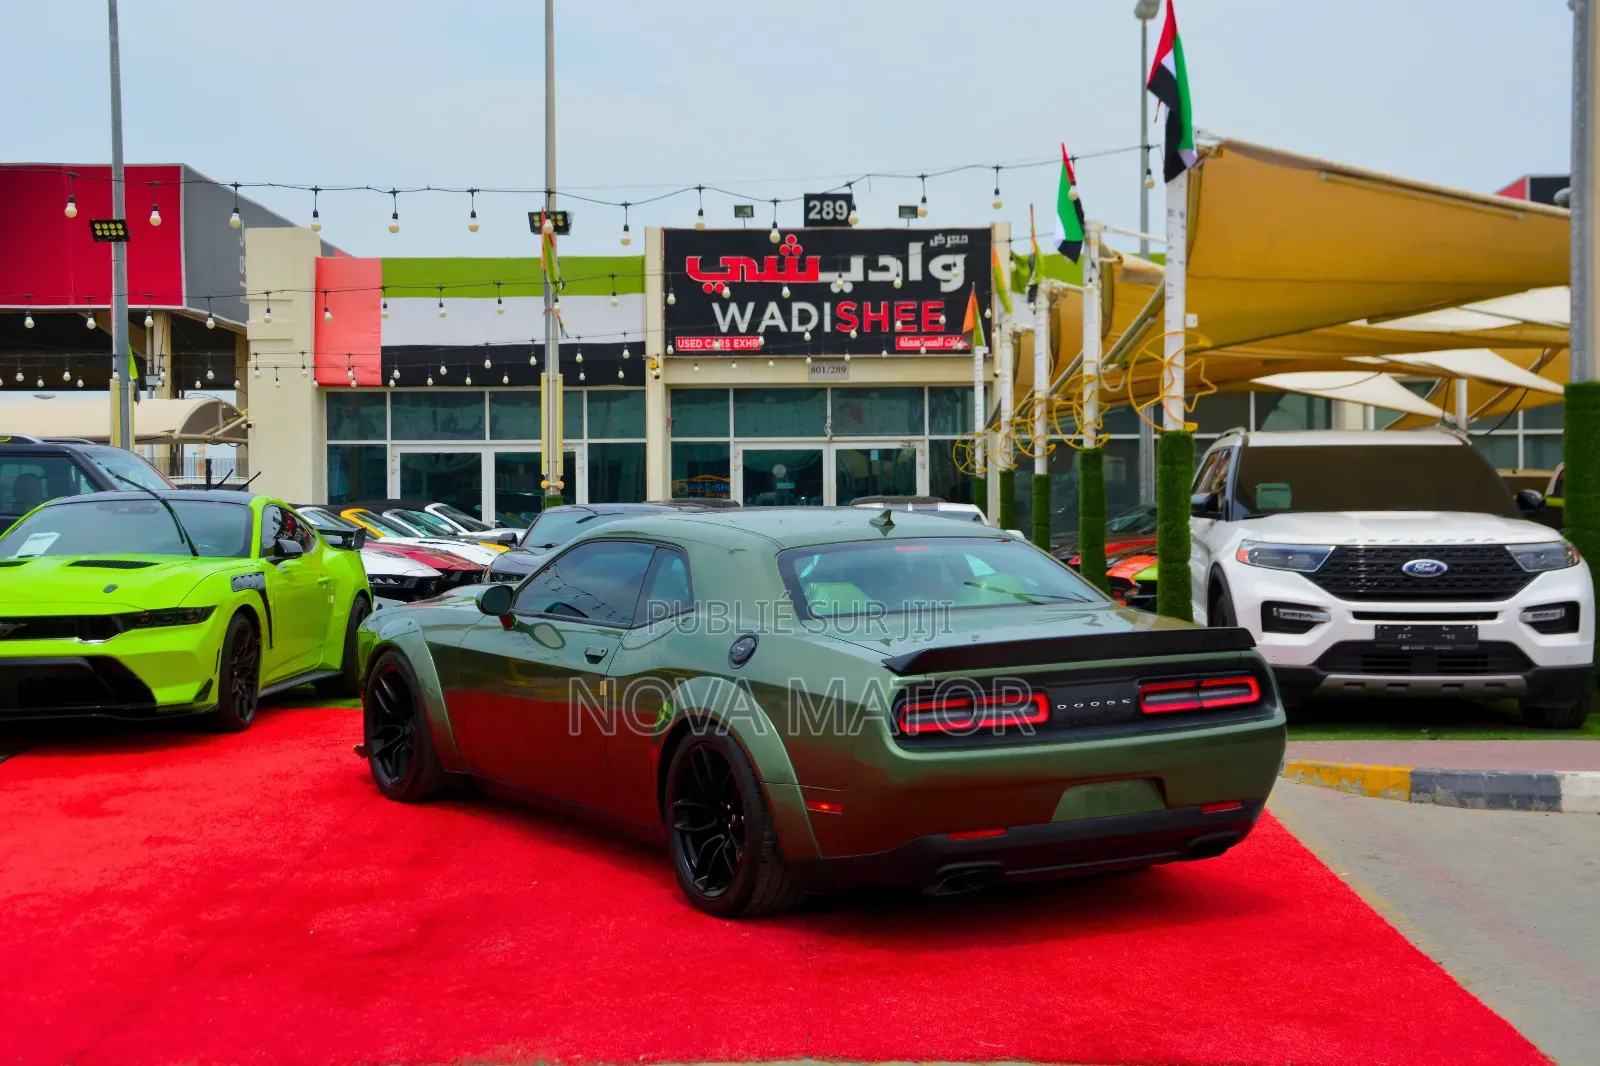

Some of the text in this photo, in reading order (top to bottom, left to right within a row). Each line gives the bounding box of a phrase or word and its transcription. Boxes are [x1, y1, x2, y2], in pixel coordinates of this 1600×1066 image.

[808, 200, 848, 220] 289
[929, 233, 969, 248] معرض
[711, 301, 946, 333] WADISHEE
[677, 339, 703, 349] USED
[733, 339, 759, 349] EXHB
[810, 365, 847, 375] 801/289
[1056, 698, 1131, 710] DODGE
